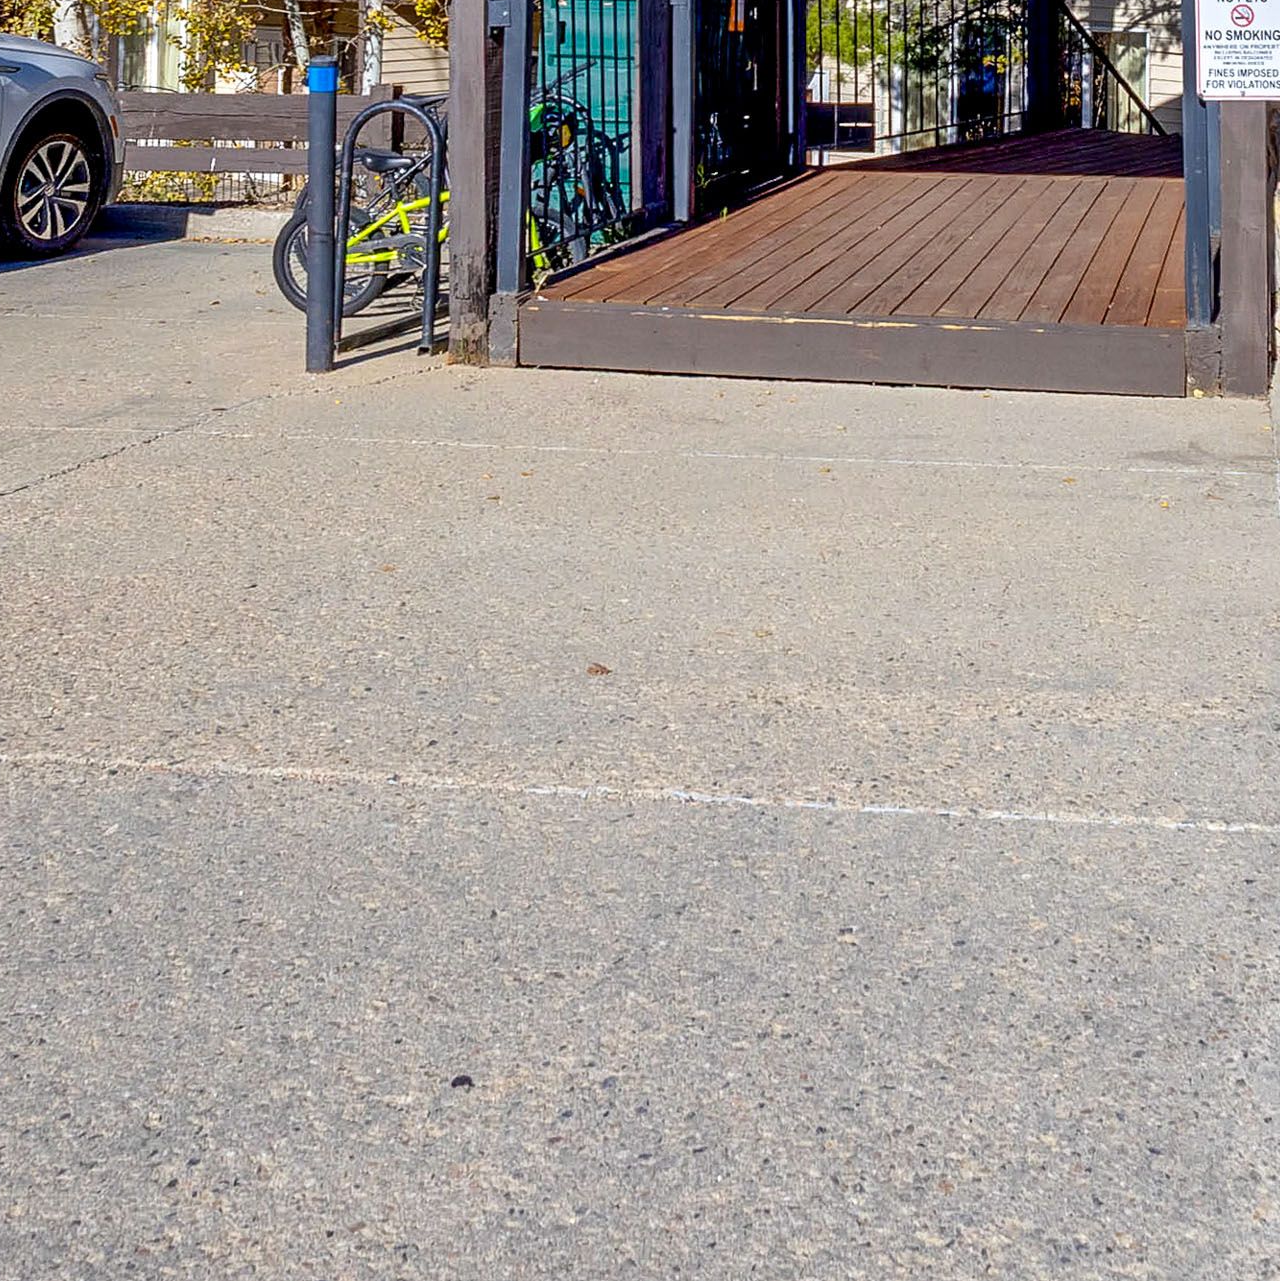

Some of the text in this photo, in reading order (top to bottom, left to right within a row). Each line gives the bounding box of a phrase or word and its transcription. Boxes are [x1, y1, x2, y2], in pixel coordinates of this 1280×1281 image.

[1205, 29, 1280, 41] NO SMOKING
[1208, 68, 1280, 78] FINES IMPOSED
[1206, 80, 1225, 89] FOR
